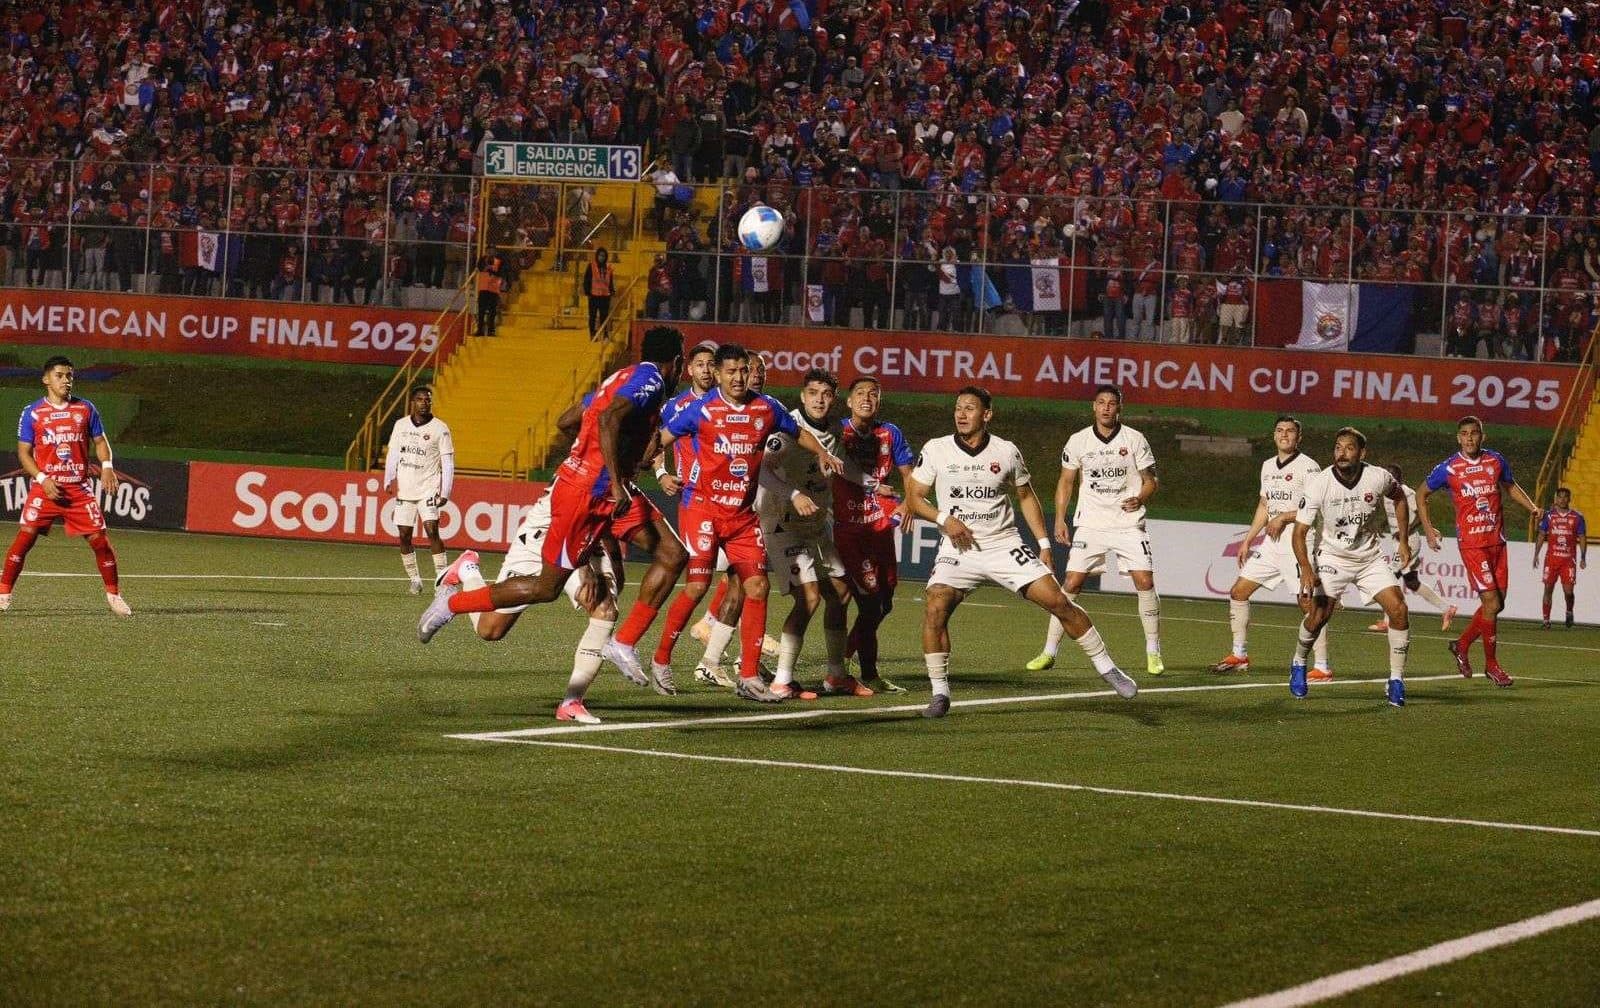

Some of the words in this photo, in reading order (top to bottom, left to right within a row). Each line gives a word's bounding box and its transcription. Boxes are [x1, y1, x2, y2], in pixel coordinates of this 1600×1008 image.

[526, 146, 578, 161] SALIDA
[579, 147, 597, 162] DE
[517, 162, 607, 177] EMERGENCIA
[611, 150, 637, 178] 13
[0, 303, 167, 338] AMERICAN
[178, 314, 239, 340] CUP
[250, 316, 338, 348] FINAL
[348, 320, 440, 353] 2025
[853, 346, 1022, 381] CENTRAL
[1034, 354, 1234, 393] AMERICAN
[1249, 367, 1319, 396] CUP
[1332, 369, 1438, 404] FINAL
[1450, 374, 1560, 411] 2025
[713, 442, 758, 455] BANRUR
[1102, 467, 1127, 478] kölbi
[232, 471, 536, 543] Scotian
[1348, 513, 1370, 526] kölb
[1010, 544, 1037, 567] 26
